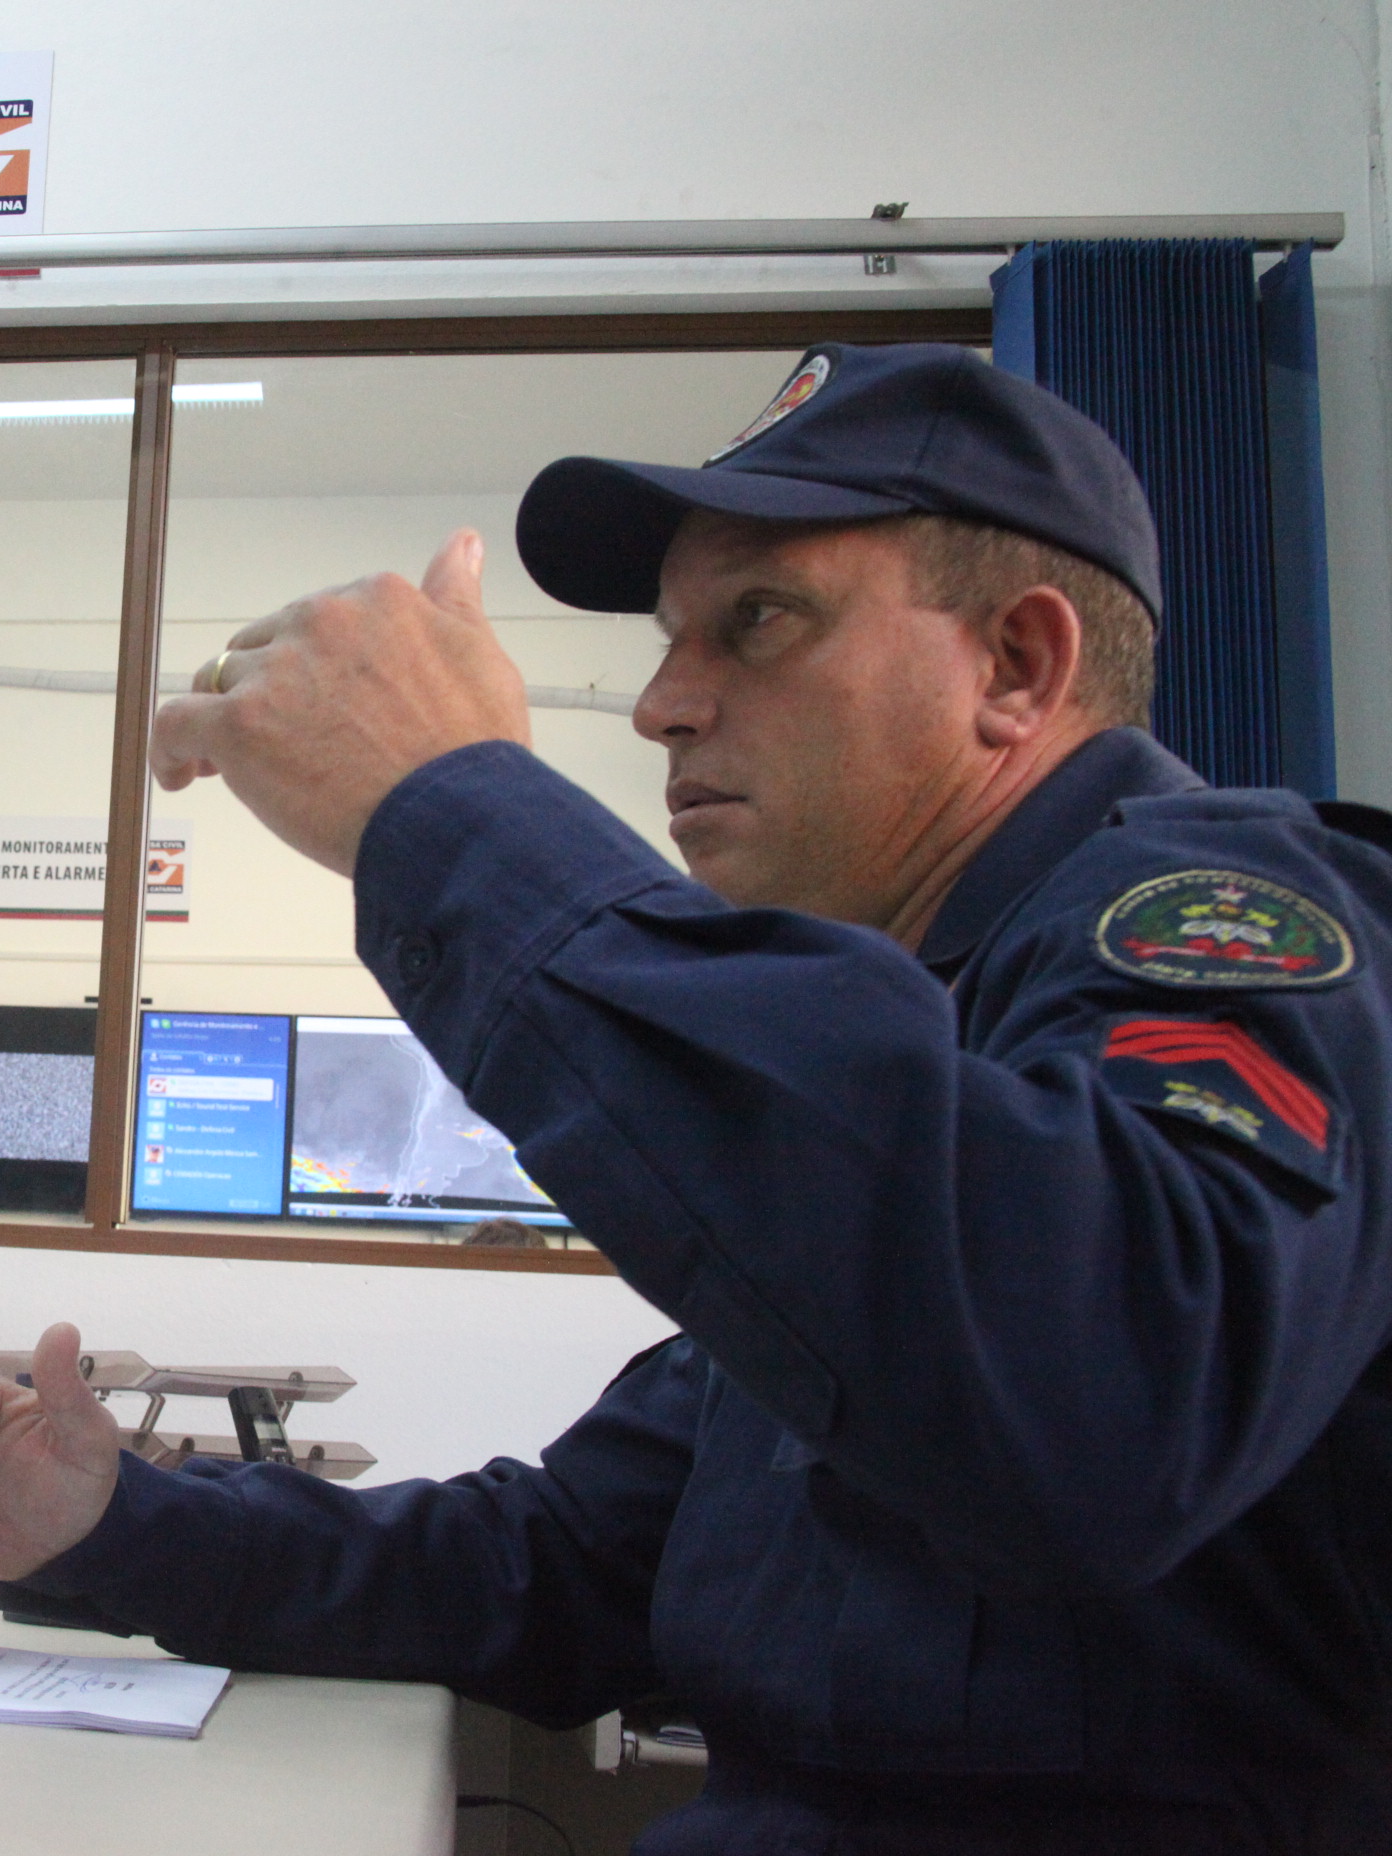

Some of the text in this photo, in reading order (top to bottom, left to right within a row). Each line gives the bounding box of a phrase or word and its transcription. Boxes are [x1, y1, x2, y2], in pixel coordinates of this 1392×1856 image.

[1, 840, 108, 854] MONITORAMENT
[33, 866, 41, 879] E
[44, 866, 105, 880] ALARME
